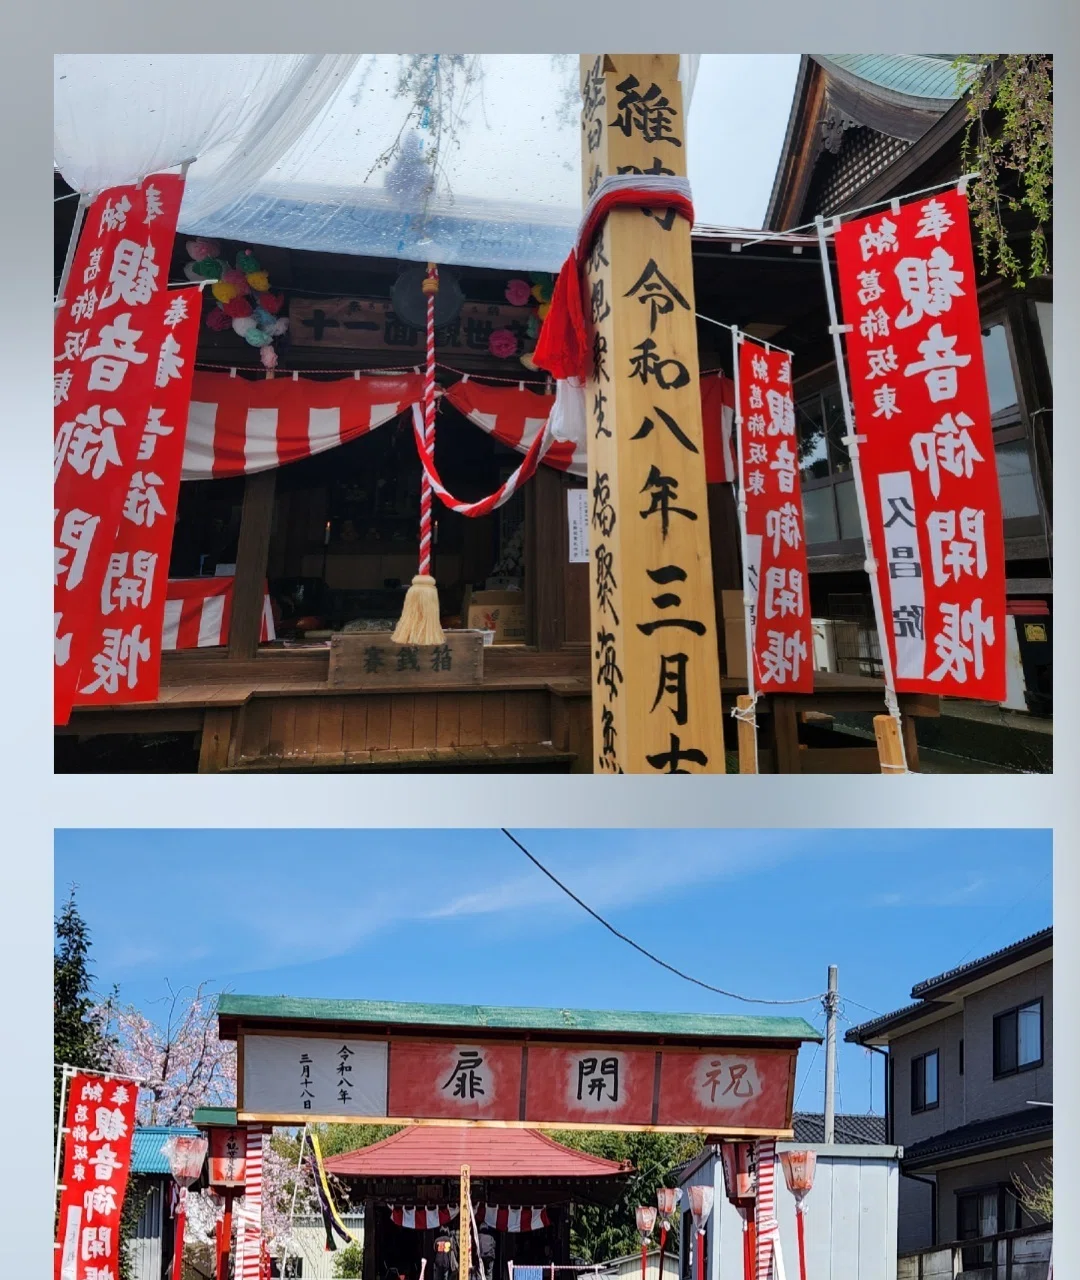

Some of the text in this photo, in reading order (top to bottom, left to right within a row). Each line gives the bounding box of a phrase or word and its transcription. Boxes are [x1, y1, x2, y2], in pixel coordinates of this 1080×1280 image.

[299, 1052, 315, 1110] 三月十八日
[336, 1044, 354, 1104] 令和八年
